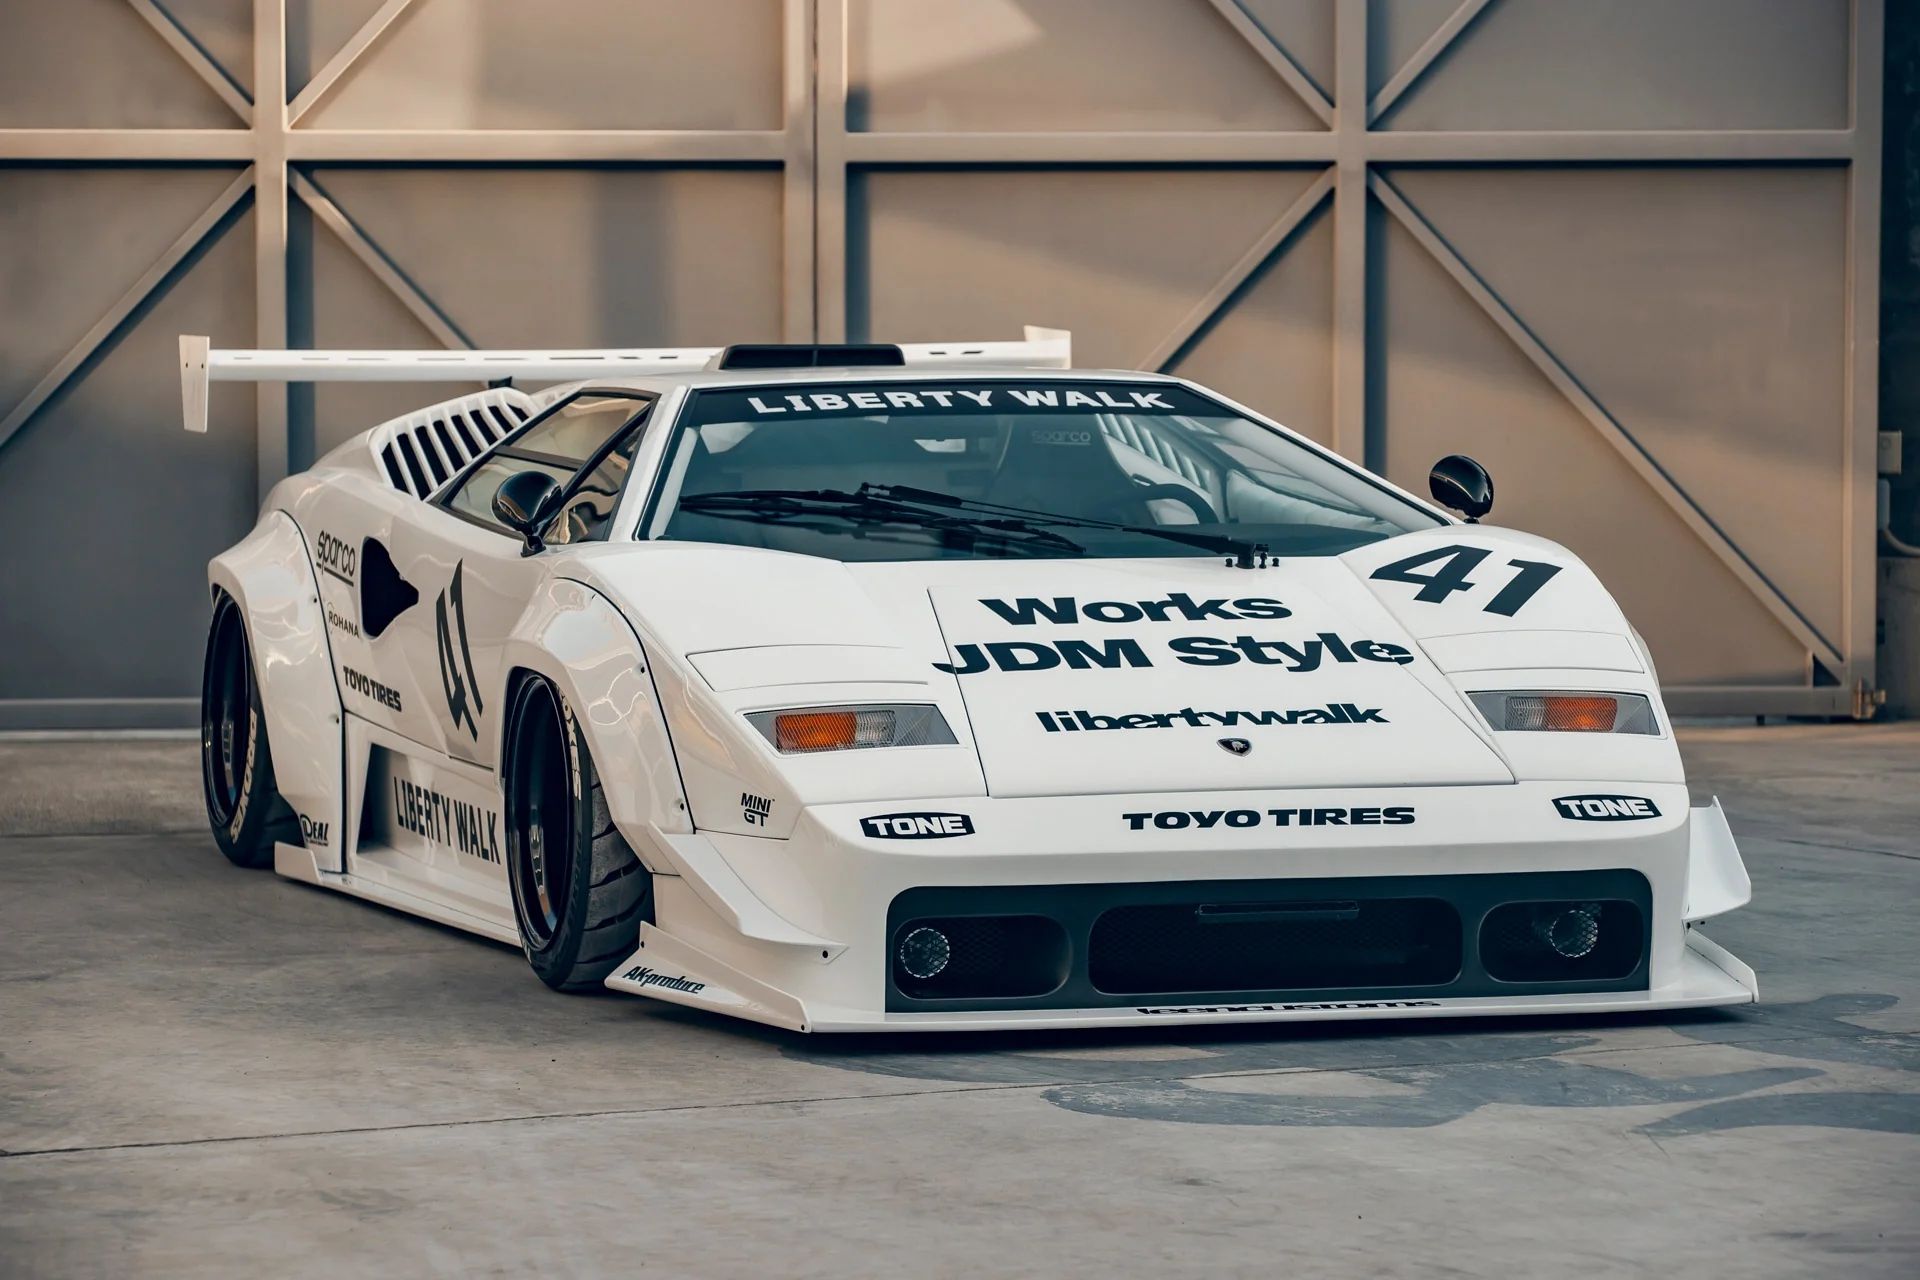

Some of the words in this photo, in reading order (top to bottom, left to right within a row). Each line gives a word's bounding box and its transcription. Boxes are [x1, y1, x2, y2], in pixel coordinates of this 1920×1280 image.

[748, 391, 993, 414] LIBERTY
[1007, 391, 1175, 409] WALK
[317, 530, 356, 577] sparco
[1369, 545, 1564, 617] 41
[327, 610, 361, 639] ROHANA
[977, 593, 1293, 626] Works
[435, 558, 484, 743] 41
[931, 639, 1155, 675] JDM
[1167, 632, 1415, 673] Style
[342, 665, 371, 697] TOYO
[369, 678, 403, 713] TIRES
[1035, 703, 1390, 733] libertywalk
[741, 792, 772, 813] MINI
[744, 808, 769, 827] GT
[1559, 799, 1655, 817] TONE
[393, 775, 451, 847] LIBERTY
[453, 799, 501, 866] WALK
[867, 815, 967, 836] TONE
[1122, 810, 1262, 831] TOYO
[1267, 807, 1416, 827] TIRES
